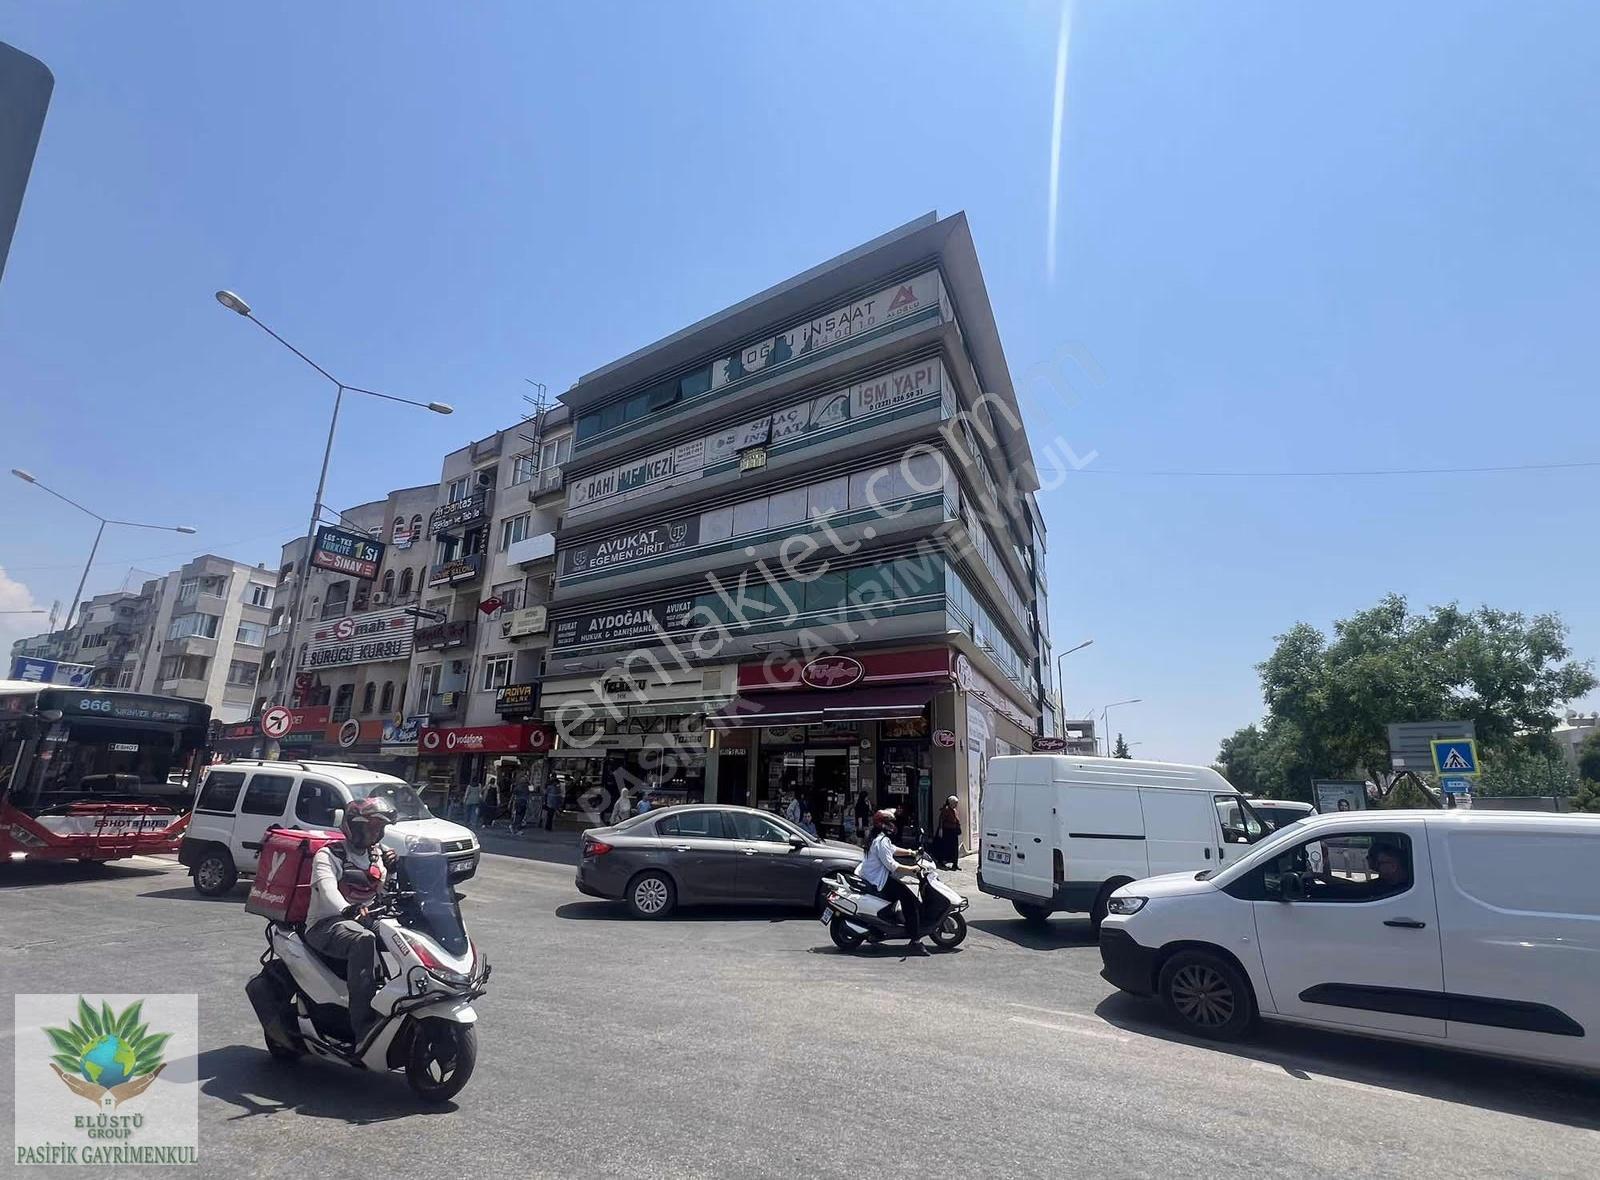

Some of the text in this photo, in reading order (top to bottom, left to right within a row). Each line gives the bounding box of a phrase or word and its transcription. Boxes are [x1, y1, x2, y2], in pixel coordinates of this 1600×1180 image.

[892, 366, 932, 397] YAPI
[596, 529, 659, 557] AVUKAT
[589, 549, 634, 568] EGEMEN
[635, 541, 665, 557] CİRİT
[334, 555, 363, 572] SINAV
[665, 601, 692, 614] AVUKAT
[588, 609, 654, 631] AYDOĞAN
[580, 632, 603, 641] HUKUK
[359, 639, 402, 659] KURSU
[80, 698, 112, 712] 866
[456, 733, 483, 745] vodafone
[95, 819, 134, 828] ESHOT
